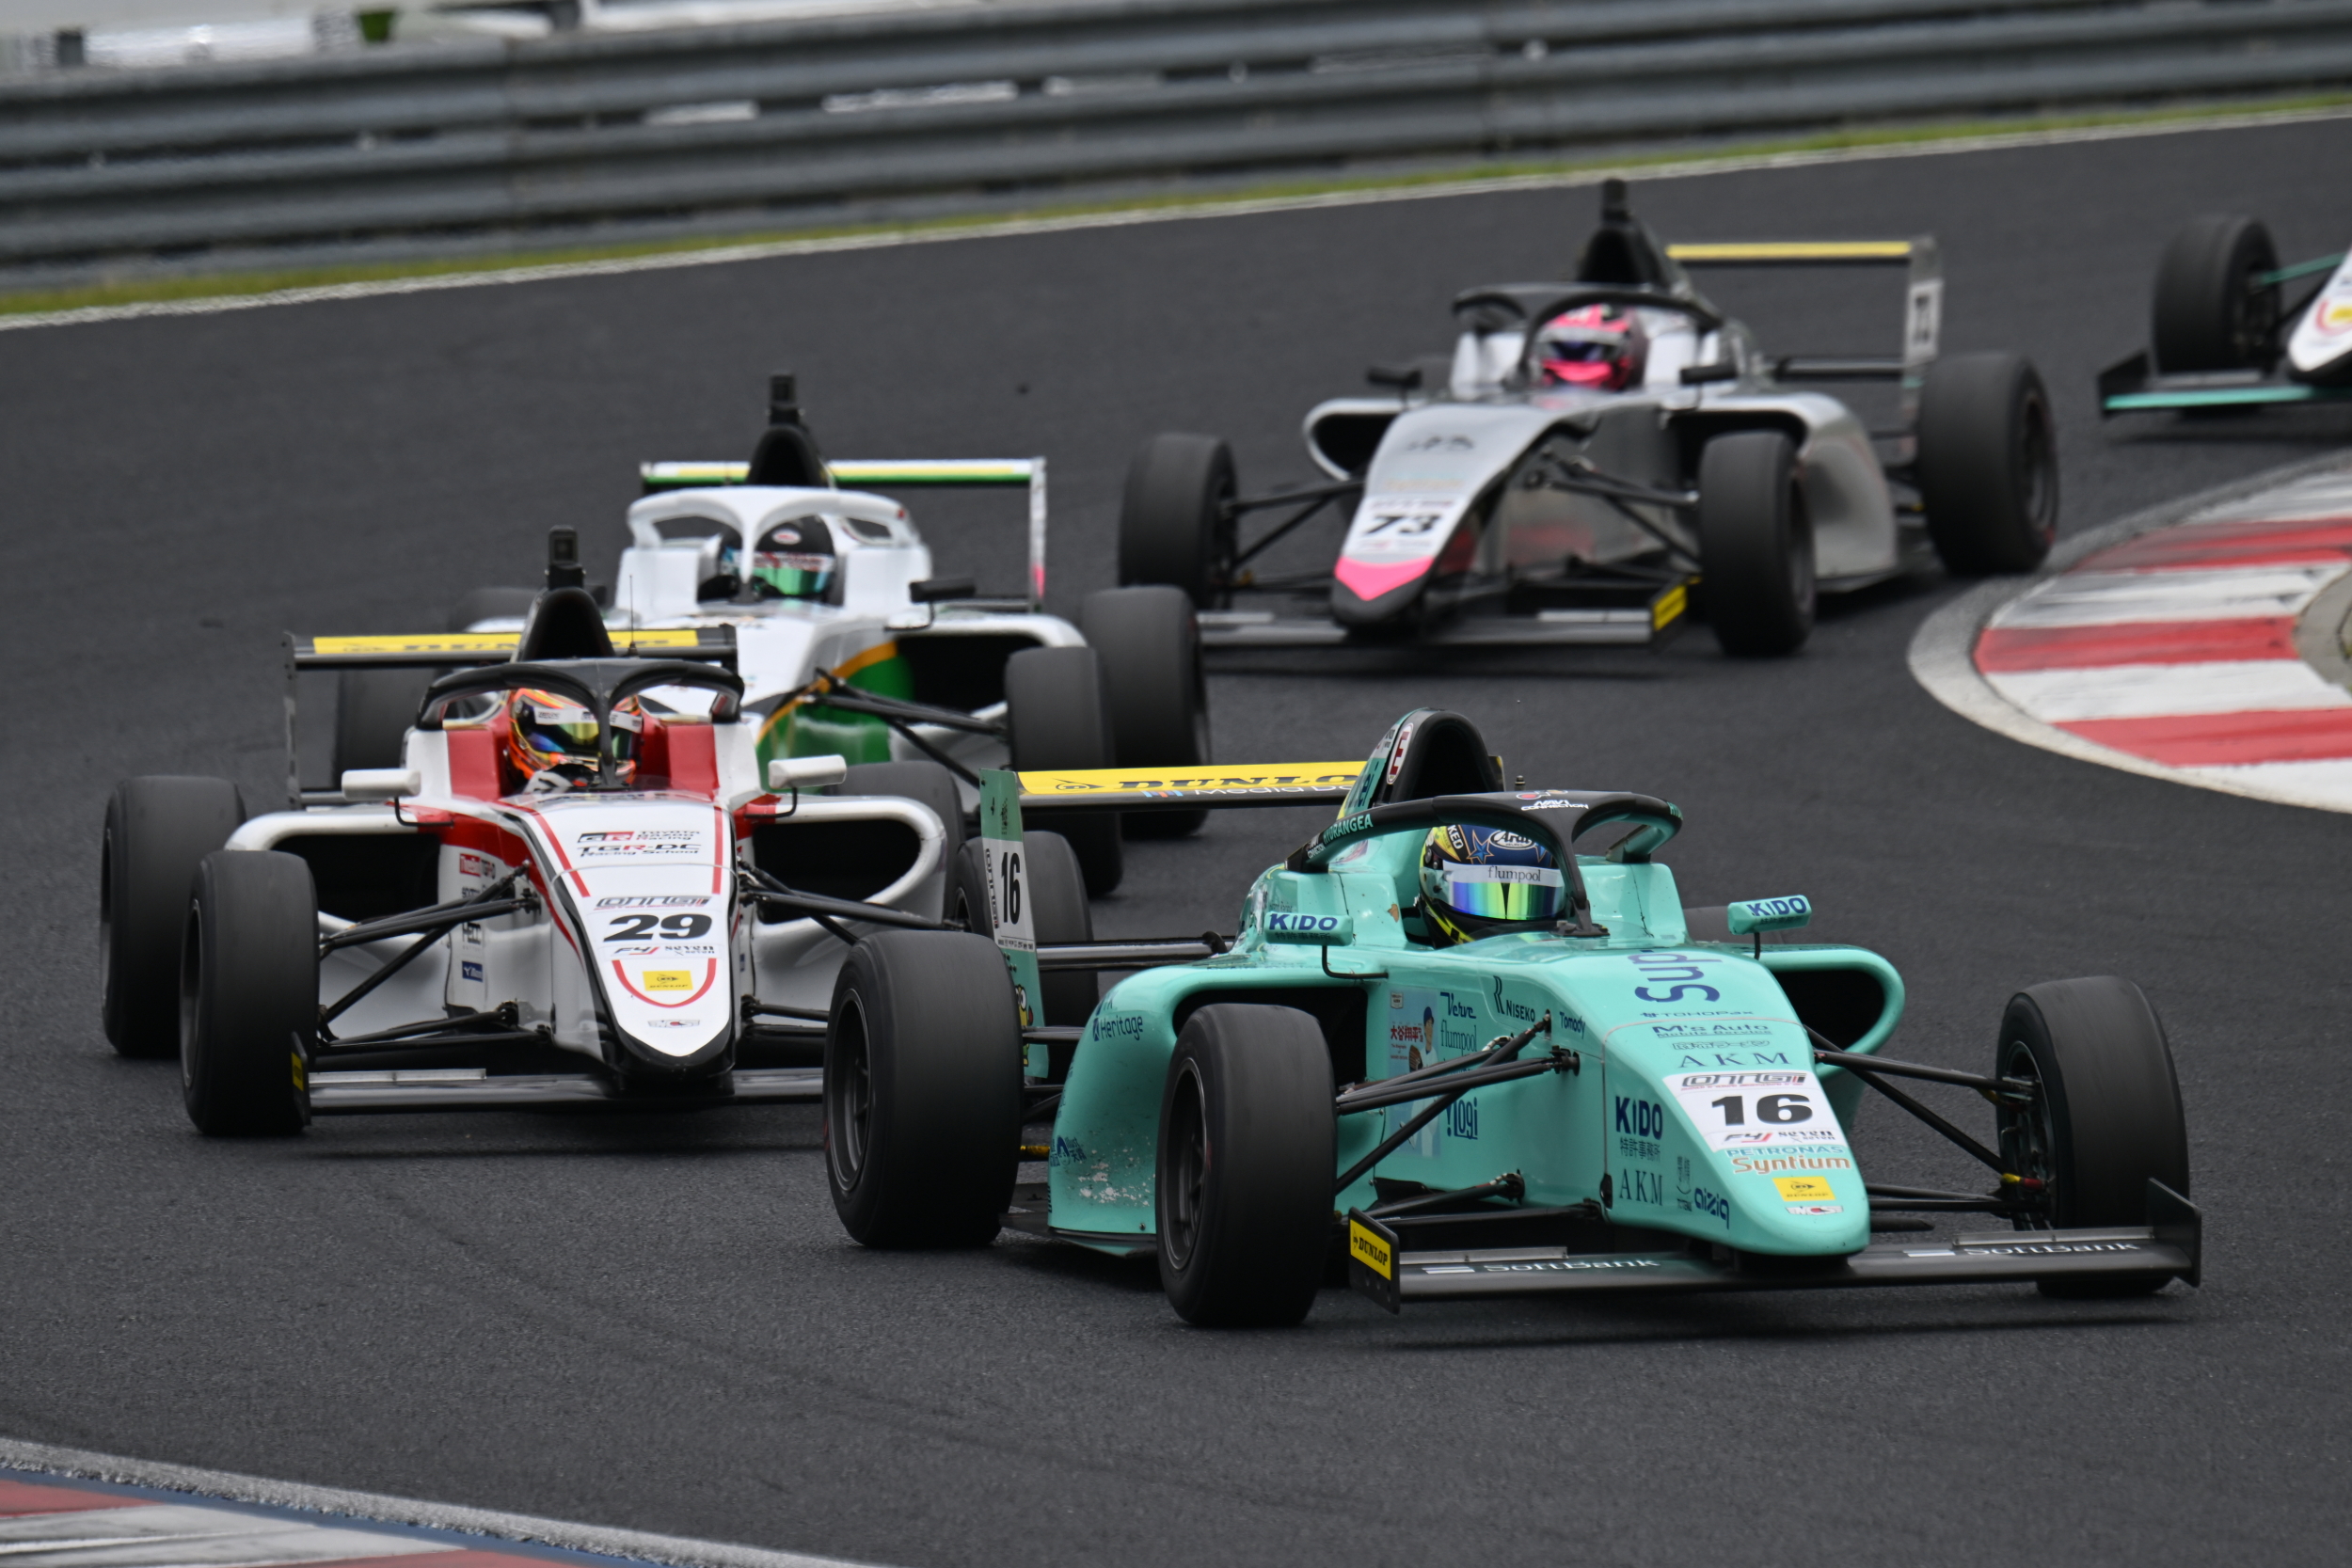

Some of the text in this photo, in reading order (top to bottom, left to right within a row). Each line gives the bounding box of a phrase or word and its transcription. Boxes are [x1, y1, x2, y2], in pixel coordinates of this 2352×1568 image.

[1365, 514, 1442, 535] 73
[1116, 774, 1360, 790] DUNLO
[1323, 814, 1373, 845] HYDRANGEA
[578, 844, 701, 852] TGR-DC
[1488, 865, 1541, 883] flumpool
[1001, 851, 1021, 925] 16
[1746, 897, 1806, 916] KIDO
[603, 913, 713, 942] 29
[1269, 913, 1338, 930] KIDO
[1628, 949, 1723, 1003] Sup
[1439, 991, 1476, 1019] Verve
[1506, 999, 1535, 1022] NISEKO
[1101, 1016, 1143, 1041] Heritage
[1440, 1020, 1477, 1057] flumpool
[1678, 1052, 1791, 1069] AKM
[1615, 1096, 1663, 1140] KIDO
[1711, 1094, 1813, 1127] 16
[1726, 1146, 1844, 1158] PETRONAS
[1732, 1155, 1851, 1175] Syntium
[1619, 1168, 1662, 1206] AKM
[1359, 1236, 1389, 1266] DUNLOP
[1963, 1242, 2141, 1256] SoftBank
[1484, 1259, 1661, 1272] SoftBank
